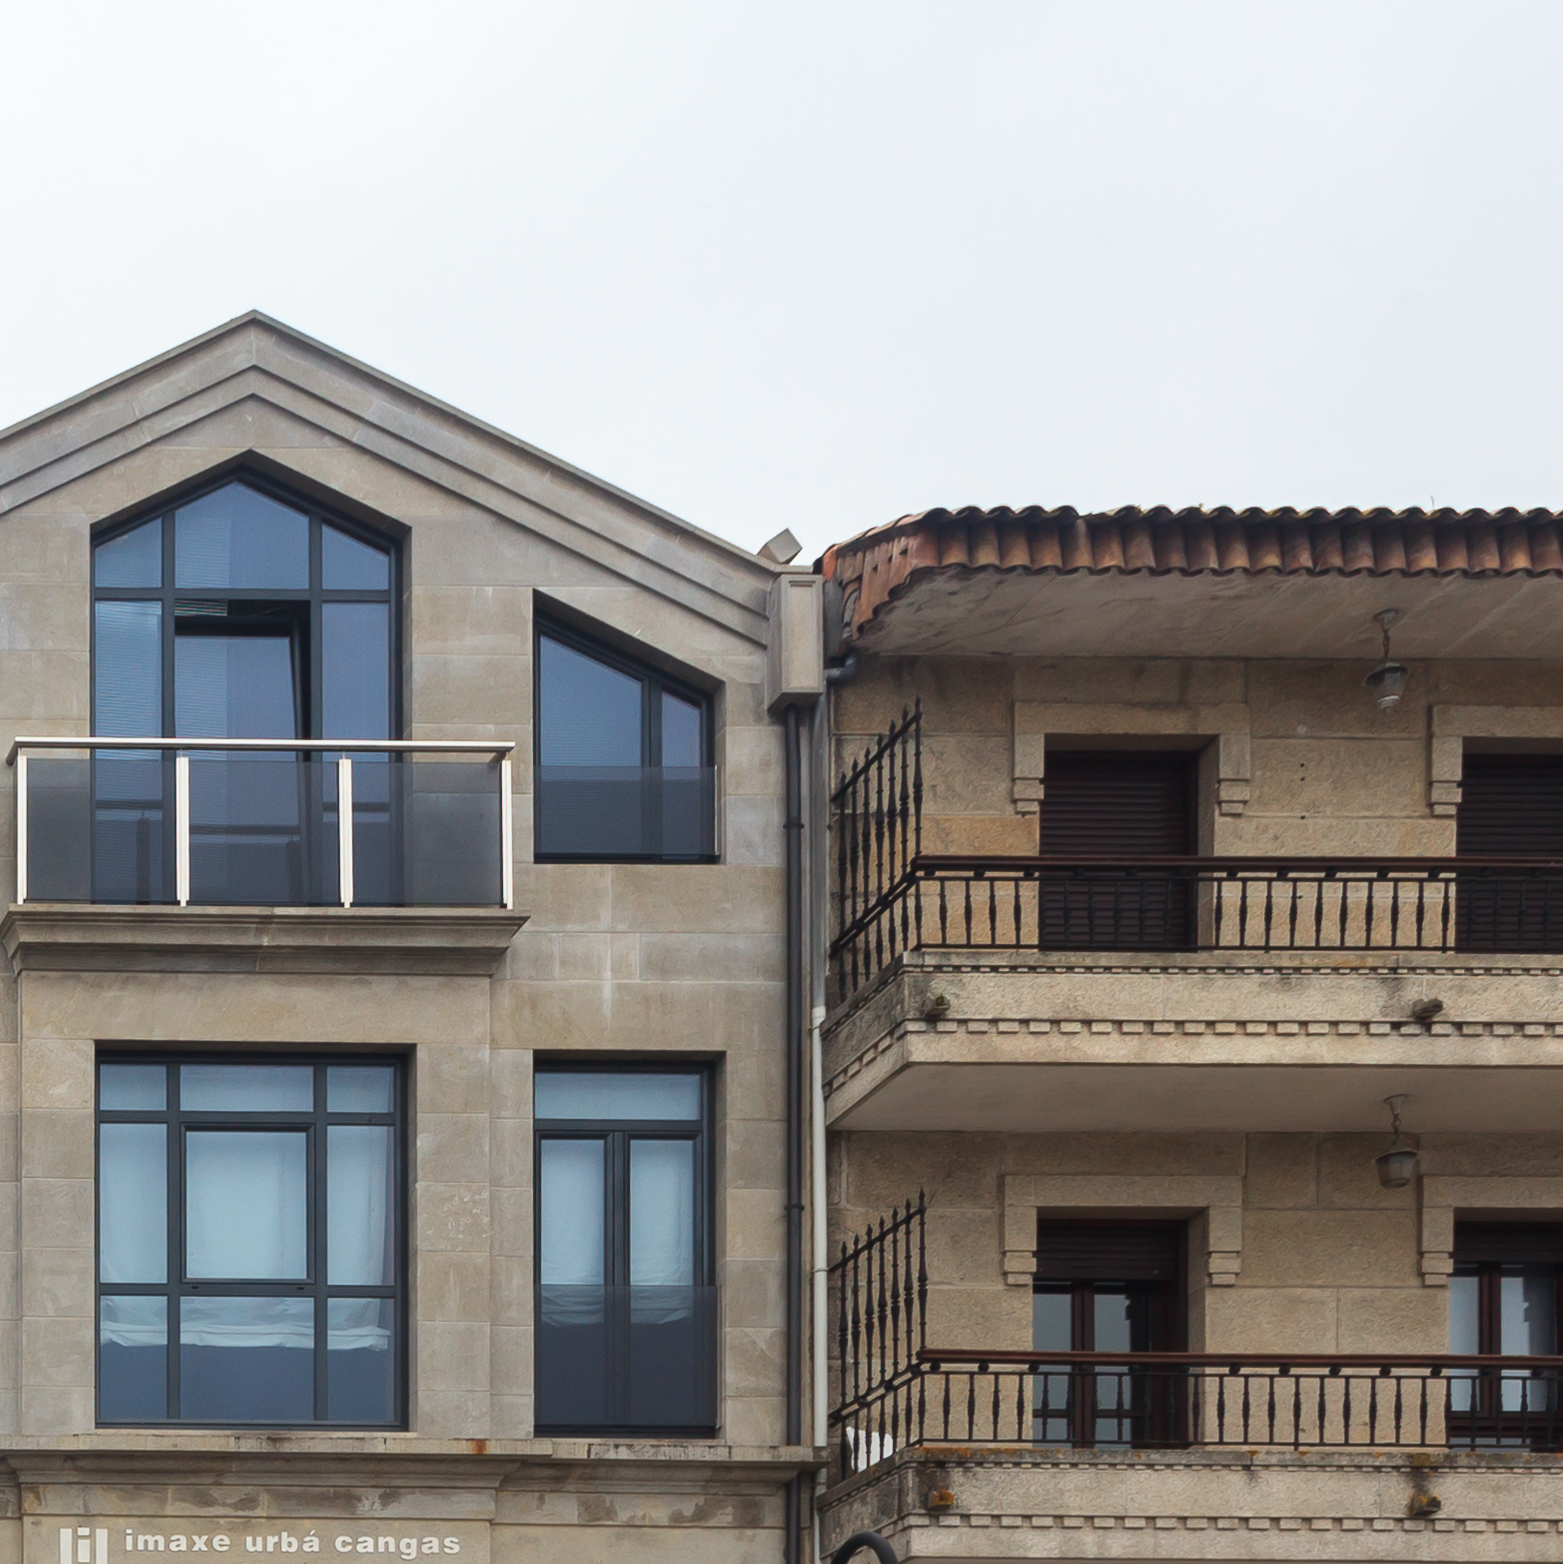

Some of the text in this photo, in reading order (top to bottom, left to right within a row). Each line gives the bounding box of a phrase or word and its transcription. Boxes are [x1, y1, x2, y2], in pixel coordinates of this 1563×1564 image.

[125, 1529, 461, 1560] imaxe urbá cangas
